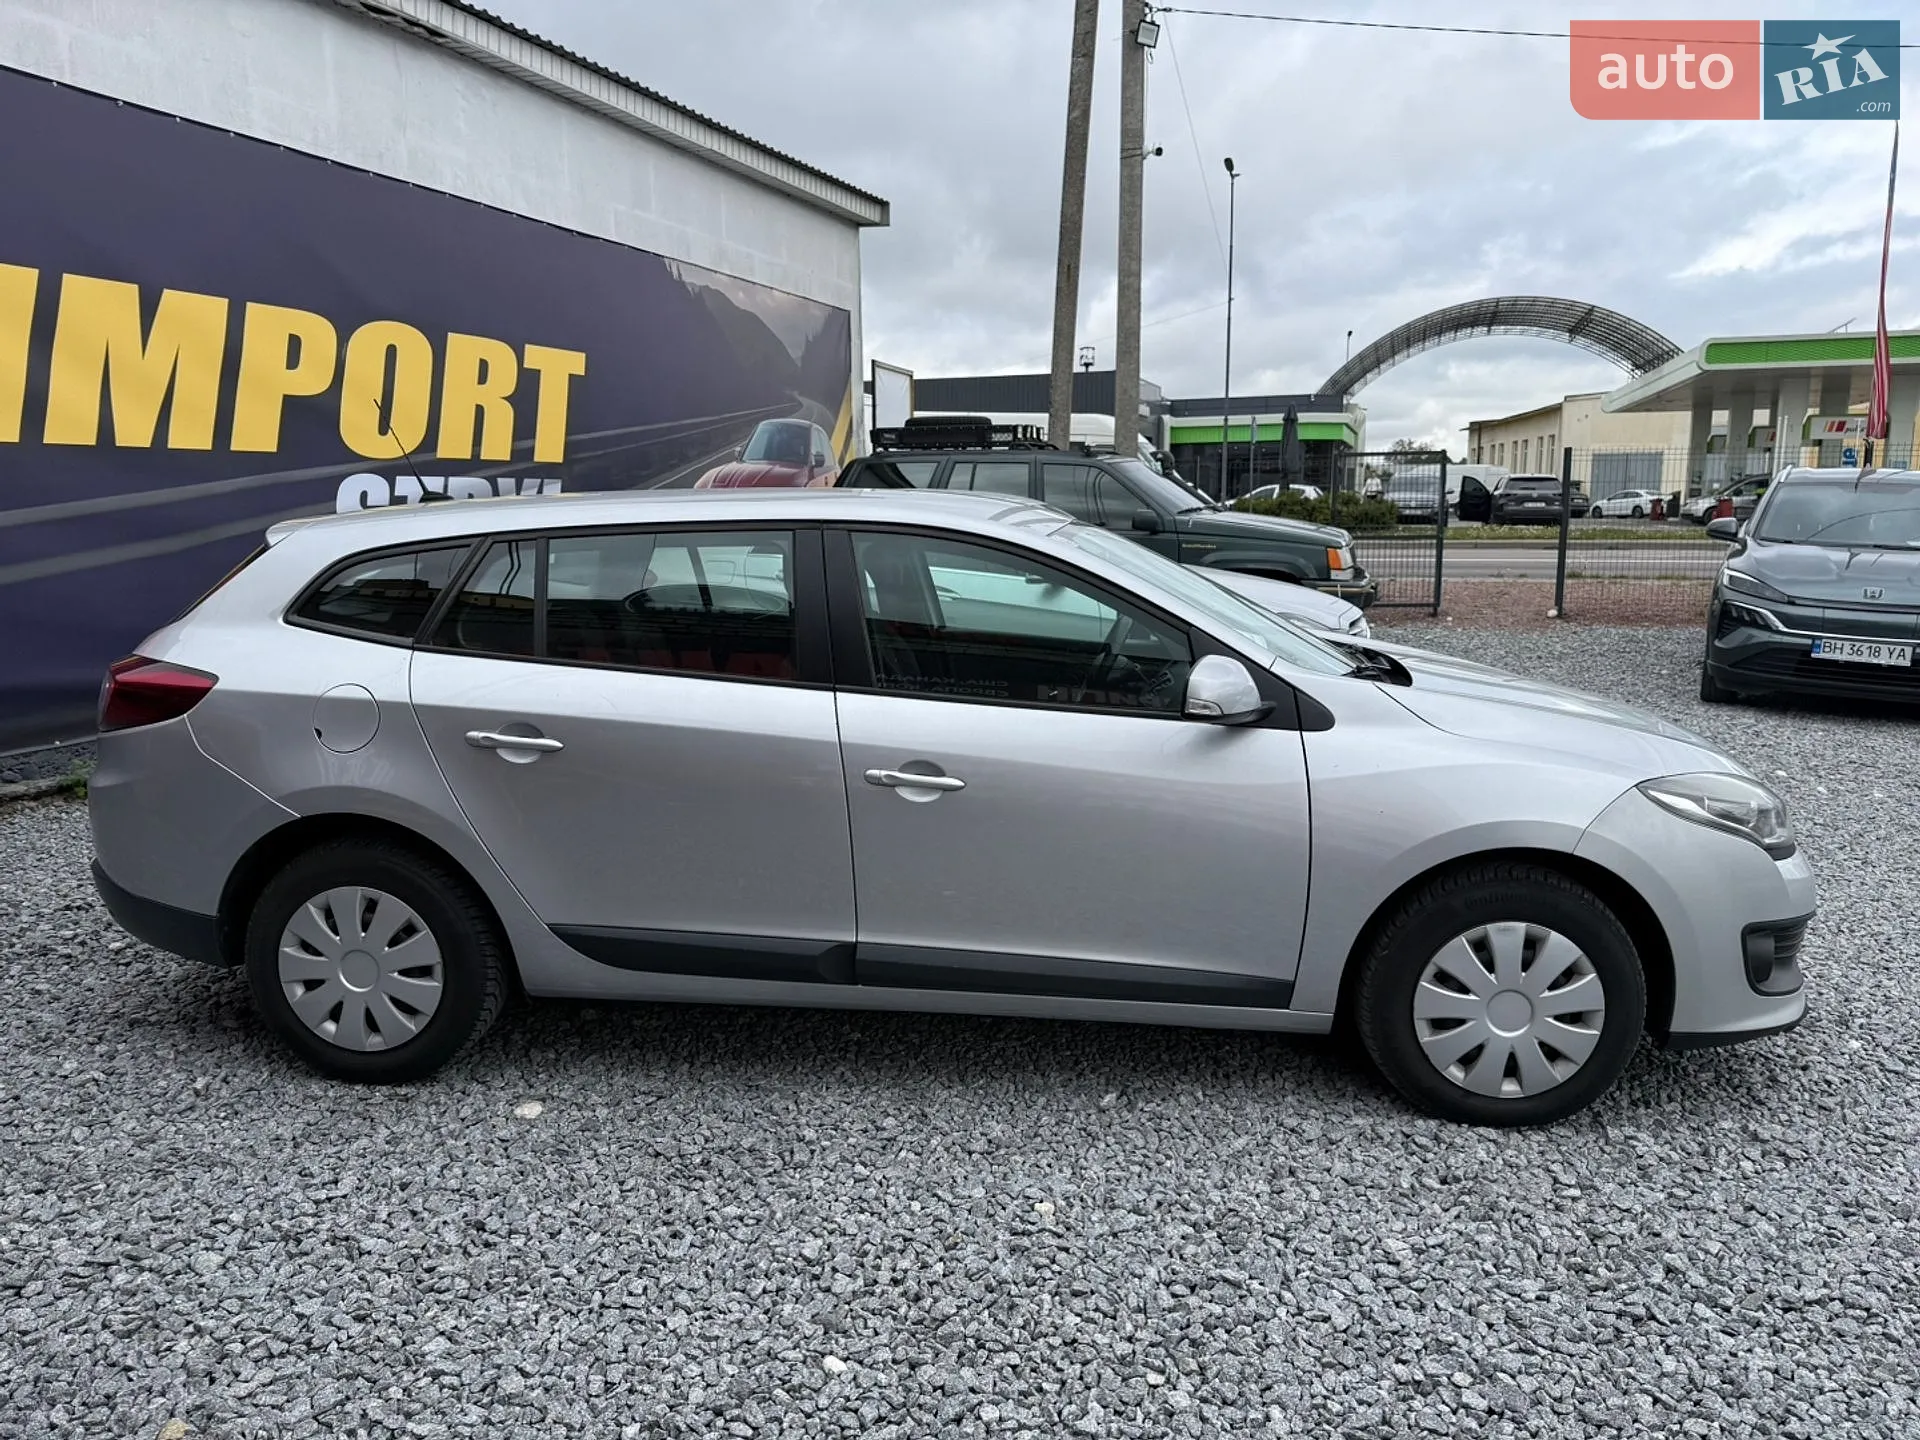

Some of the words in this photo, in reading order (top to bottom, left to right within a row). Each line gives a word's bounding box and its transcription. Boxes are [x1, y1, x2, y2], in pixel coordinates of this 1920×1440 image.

[0, 262, 586, 464] IMPORT
[1822, 641, 1845, 655] BH
[1846, 643, 1882, 658] 3618
[1887, 646, 1906, 660] YA
